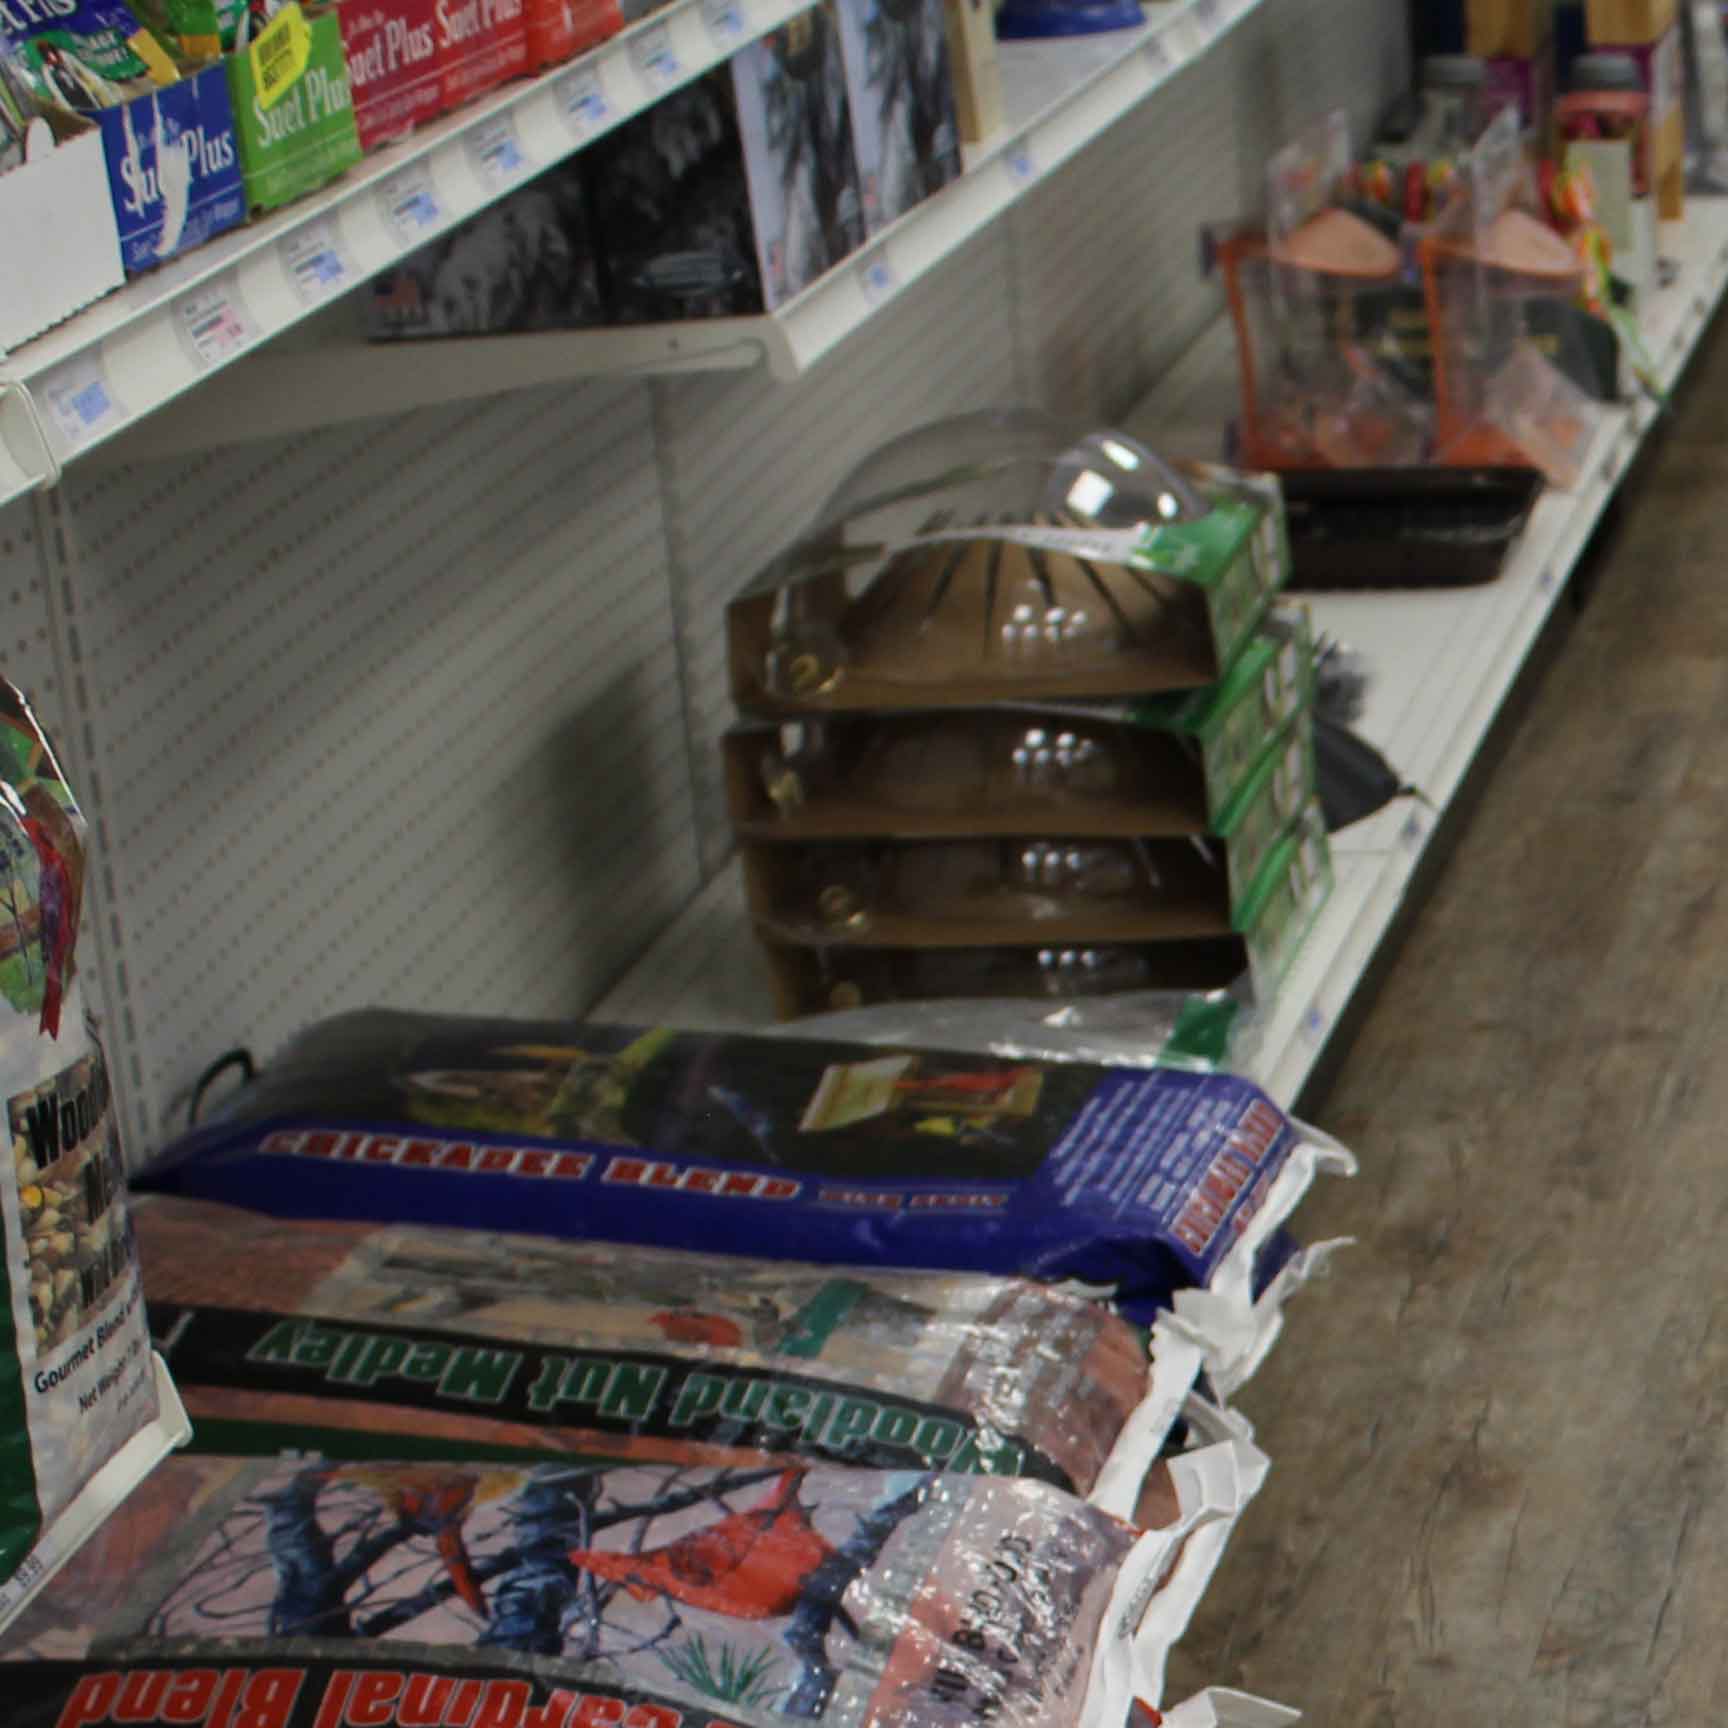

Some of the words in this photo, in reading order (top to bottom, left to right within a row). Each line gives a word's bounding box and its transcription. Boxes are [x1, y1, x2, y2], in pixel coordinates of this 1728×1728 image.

[385, 16, 434, 73] Plus
[181, 125, 235, 177] Plus
[258, 1129, 596, 1180] CHICKADEE
[600, 1157, 803, 1199] BLEND
[35, 1333, 95, 1395] Gourmet
[246, 1316, 523, 1402] Medley
[528, 1354, 669, 1422] Nut
[668, 1372, 1028, 1478] Woodland
